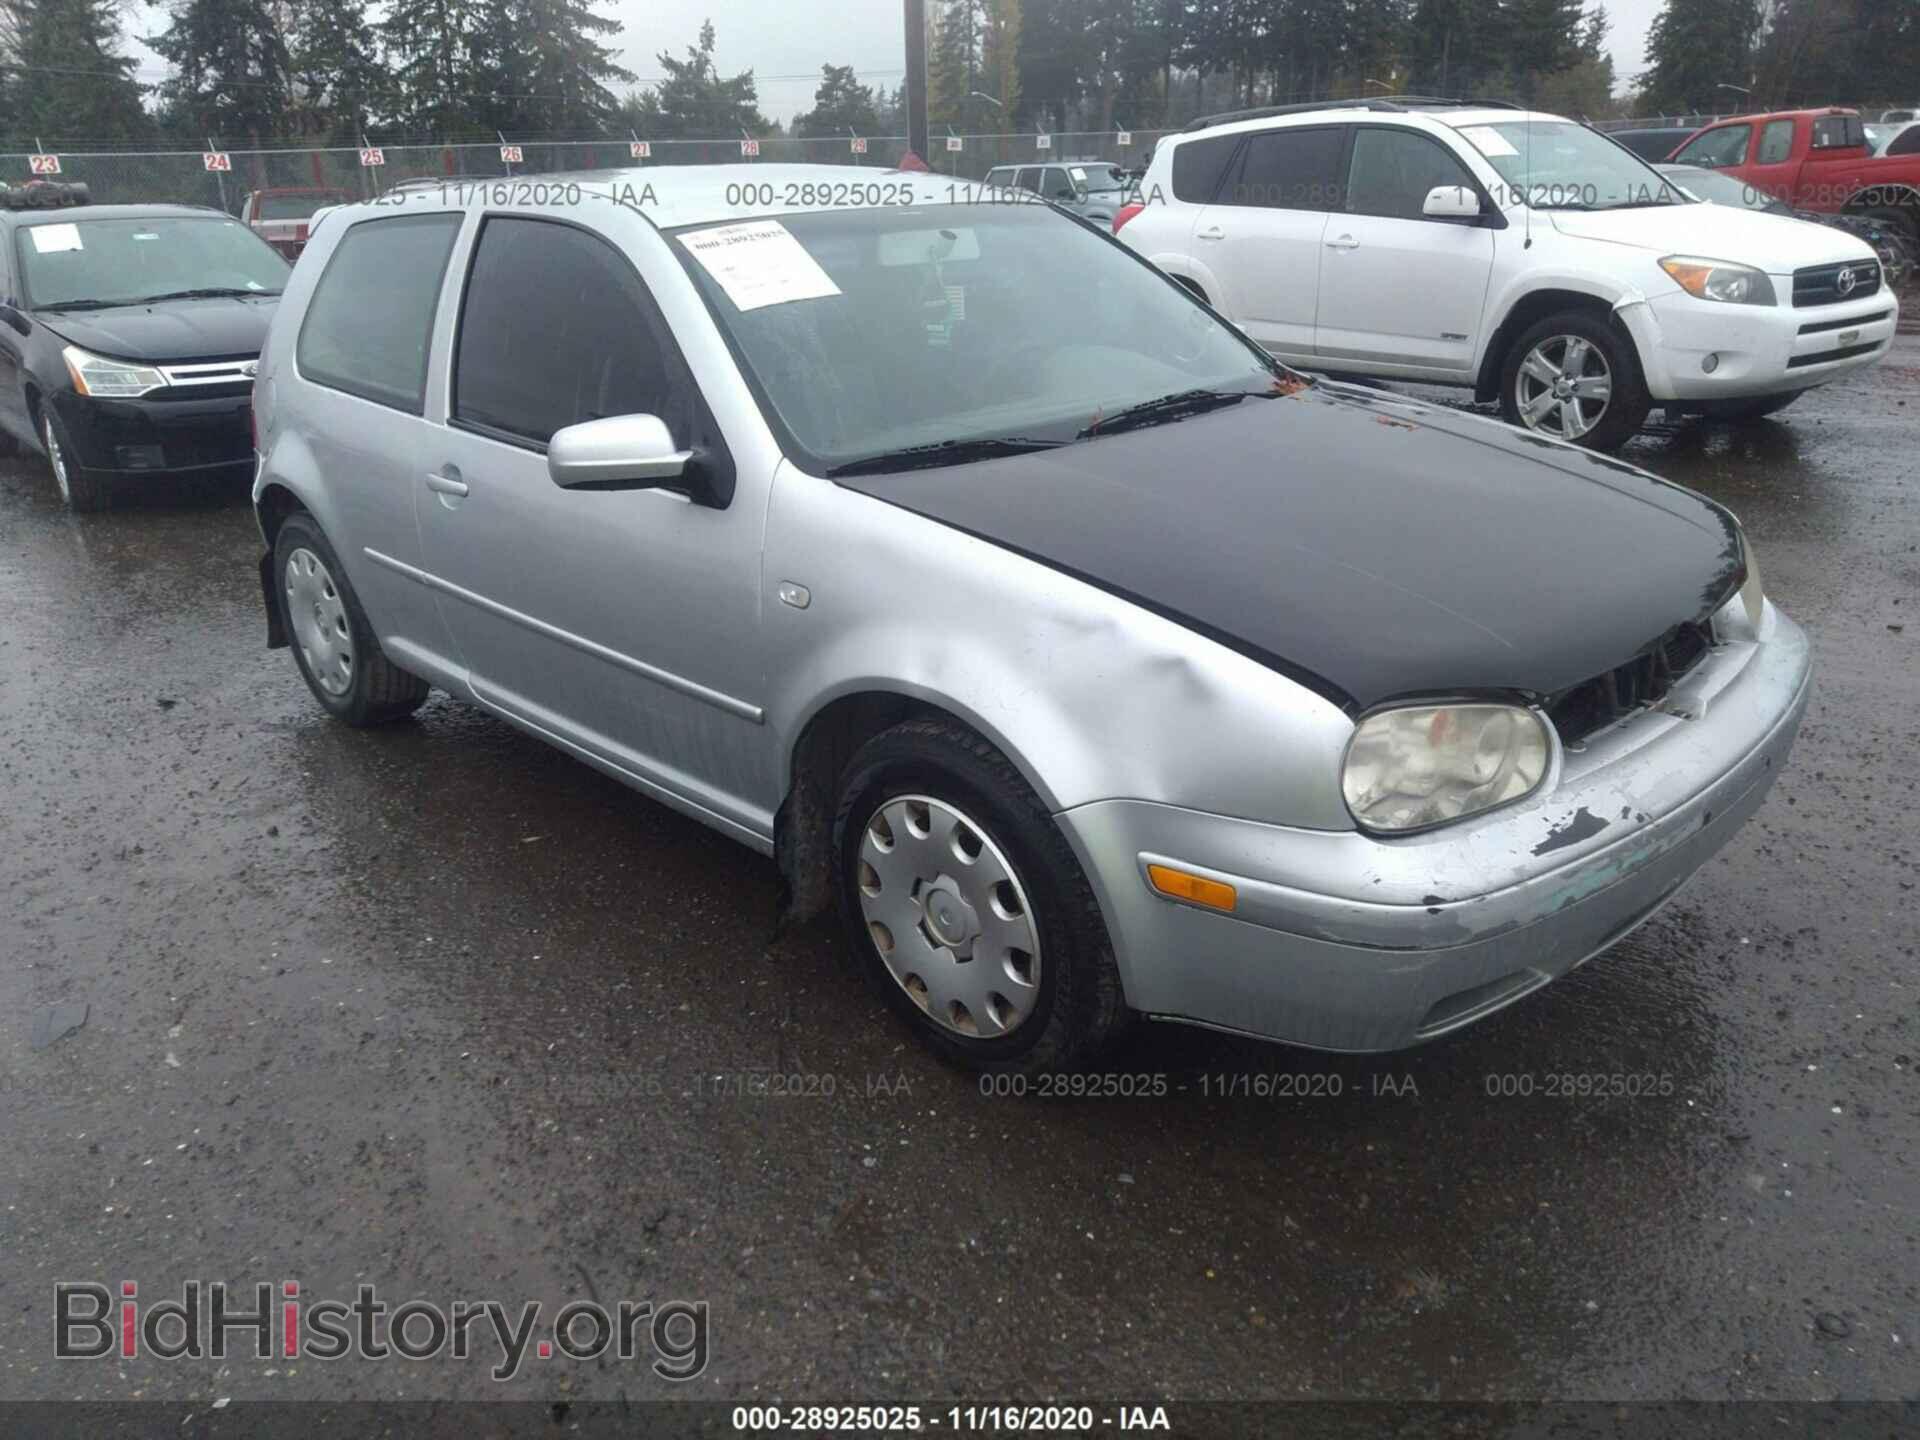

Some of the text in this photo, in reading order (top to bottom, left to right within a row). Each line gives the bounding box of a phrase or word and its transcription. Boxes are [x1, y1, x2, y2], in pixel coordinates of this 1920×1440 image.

[502, 147, 521, 162] 26
[632, 143, 647, 156] 27
[743, 142, 757, 155] 28
[32, 156, 58, 173] 23
[206, 154, 229, 171] 24
[362, 149, 383, 165] 25
